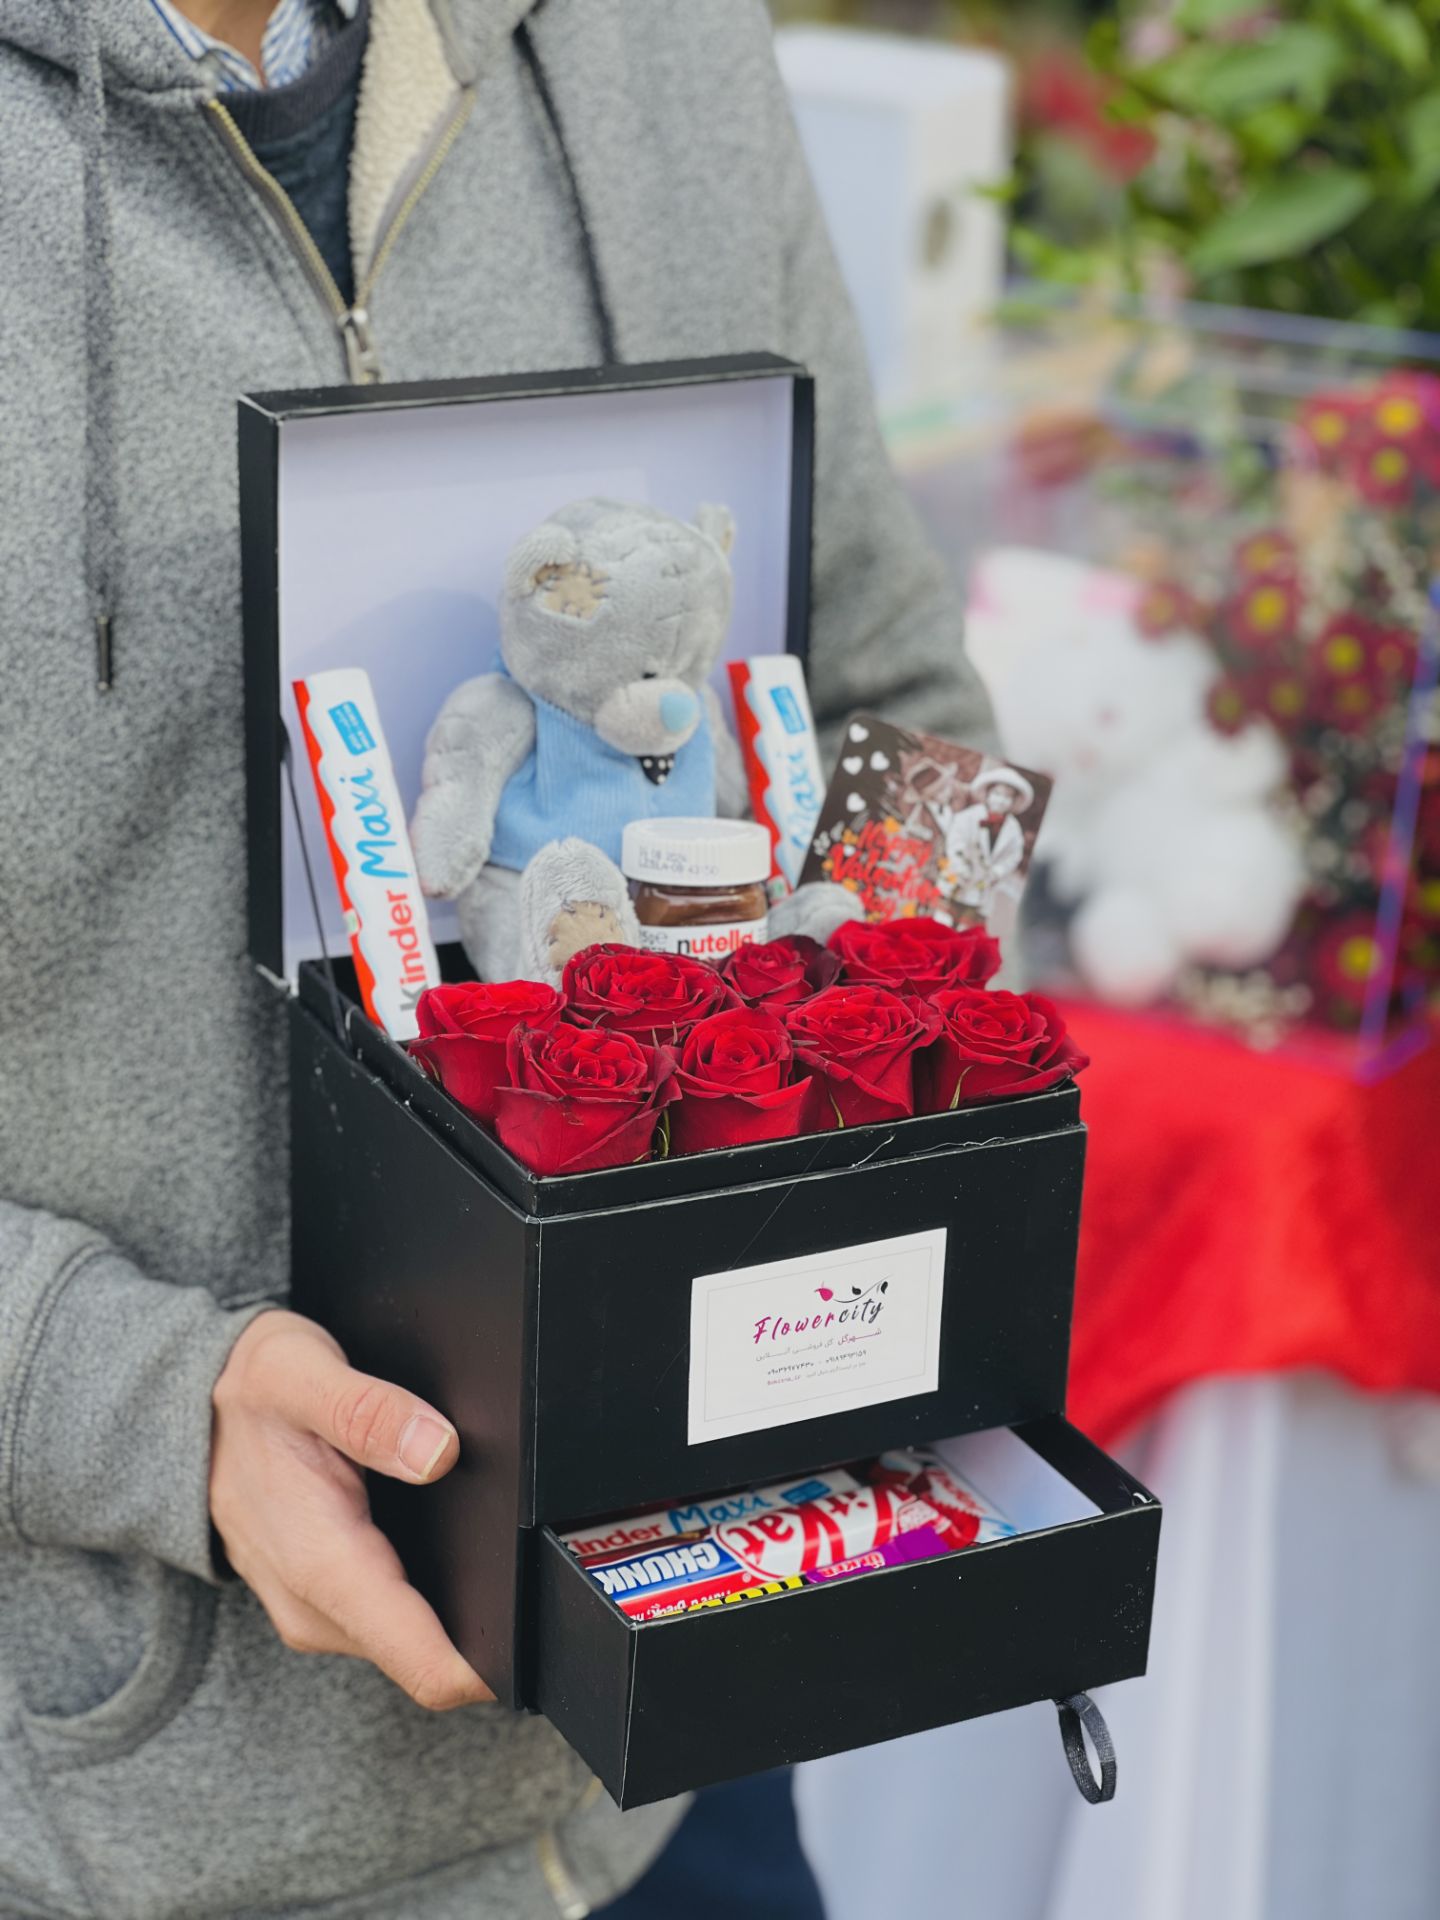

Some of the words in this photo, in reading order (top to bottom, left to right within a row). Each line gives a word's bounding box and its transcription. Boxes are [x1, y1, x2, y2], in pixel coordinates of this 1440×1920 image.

[338, 767, 410, 879] Maxi
[386, 889, 429, 1012] Kinder
[752, 1298, 884, 1344] Flowercity
[564, 1524, 663, 1556] inder
[666, 1490, 773, 1535] Maxi
[592, 1541, 721, 1595] CHUNK
